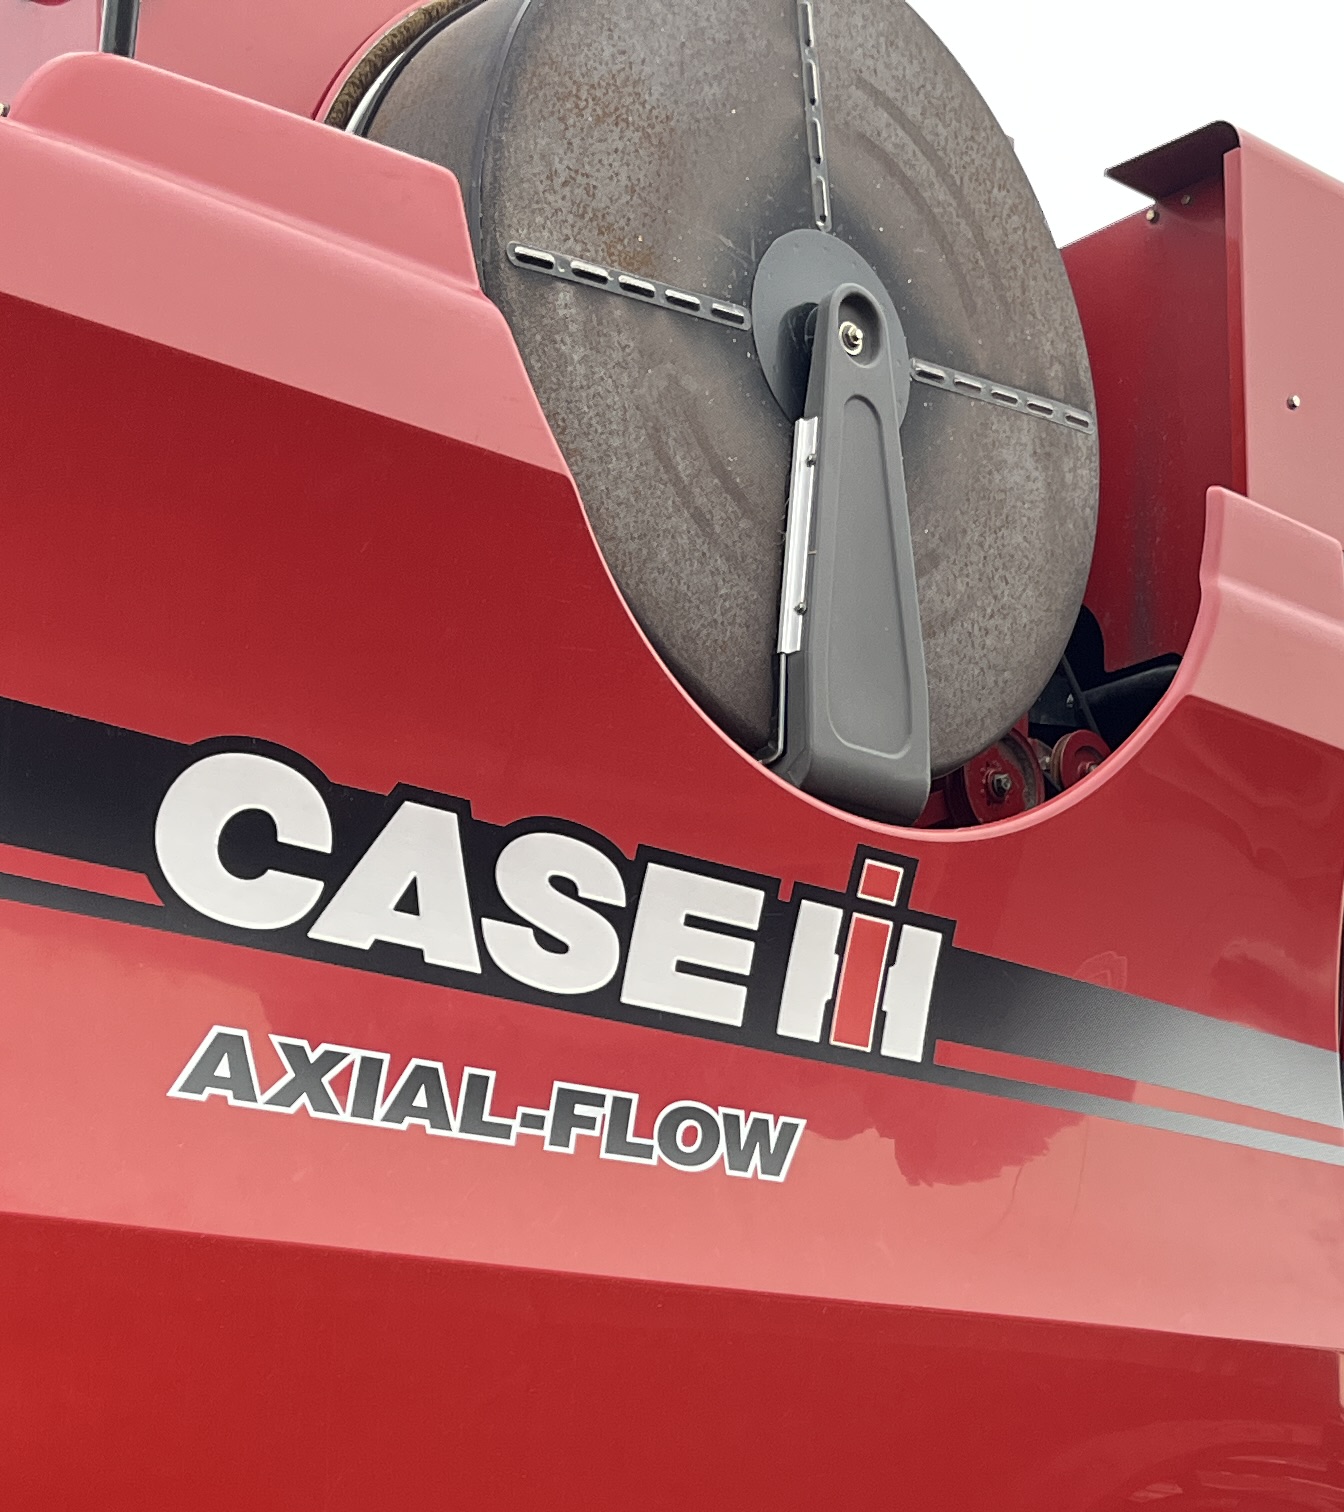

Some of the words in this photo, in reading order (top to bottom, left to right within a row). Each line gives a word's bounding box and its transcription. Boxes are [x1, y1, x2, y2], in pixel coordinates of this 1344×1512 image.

[155, 752, 766, 1026] CASE
[777, 857, 943, 1063] IH
[167, 1024, 807, 1184] AXIAL-FLOW
